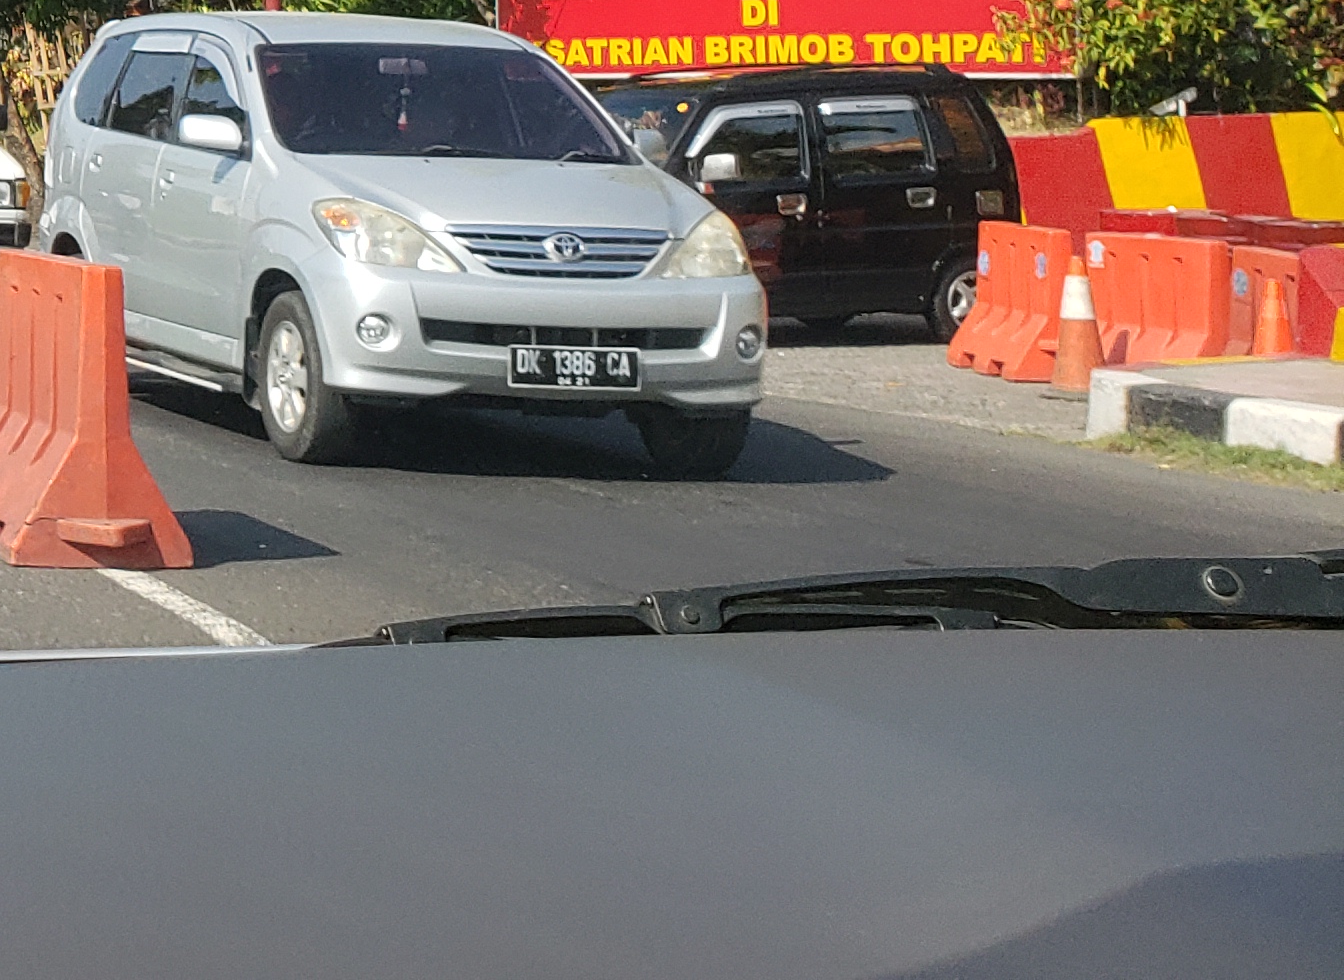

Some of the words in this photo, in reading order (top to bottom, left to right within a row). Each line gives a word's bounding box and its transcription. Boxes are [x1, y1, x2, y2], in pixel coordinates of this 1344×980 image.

[533, 35, 694, 67] SATRIAN
[705, 32, 855, 66] BRIMOB
[515, 348, 542, 375] DK
[552, 350, 597, 377] 1386
[606, 352, 631, 379] CA
